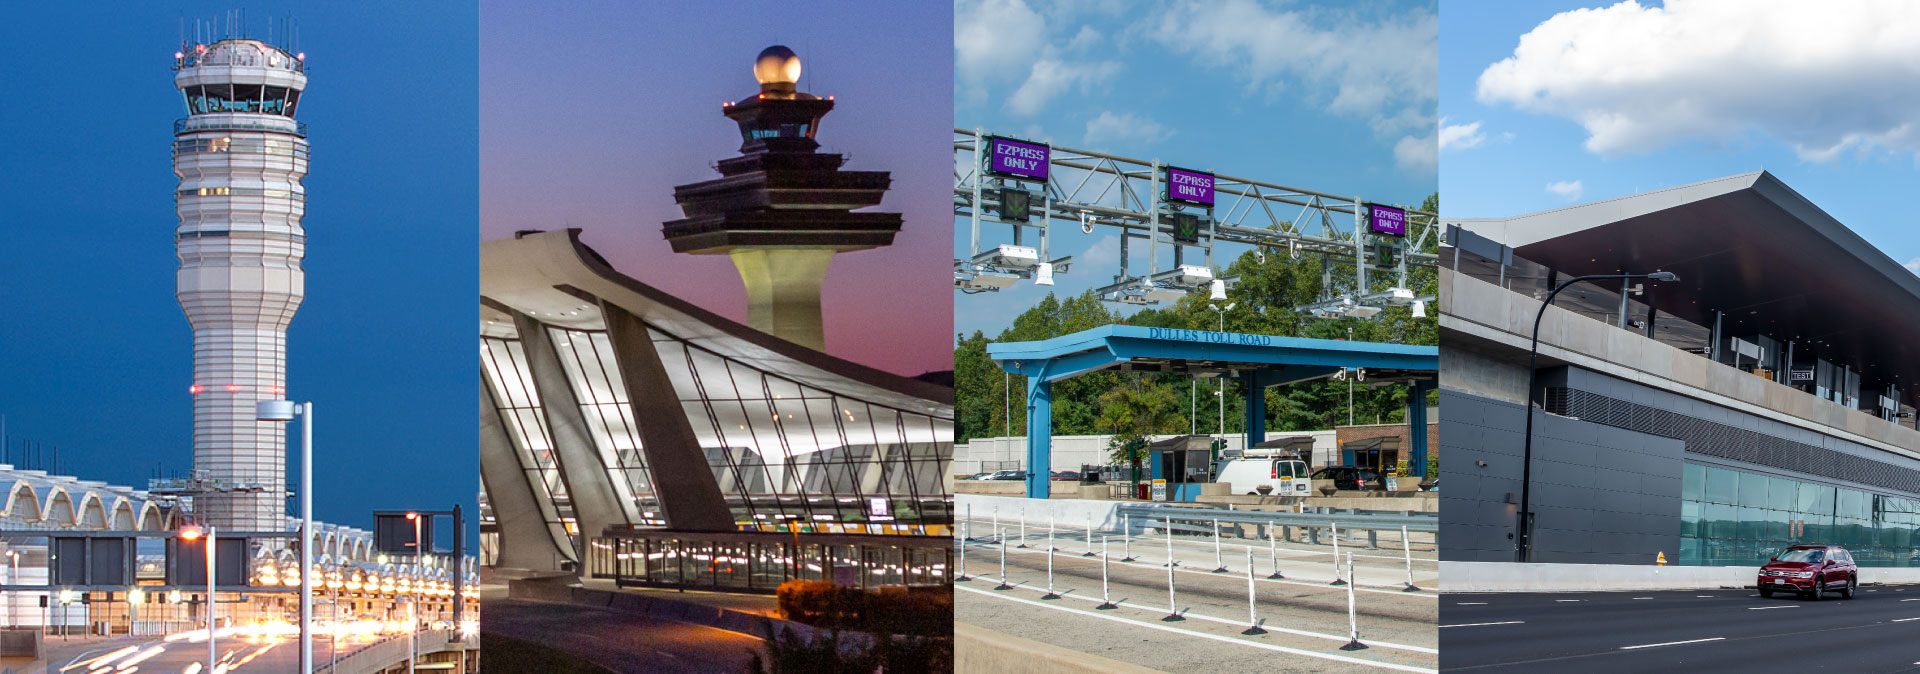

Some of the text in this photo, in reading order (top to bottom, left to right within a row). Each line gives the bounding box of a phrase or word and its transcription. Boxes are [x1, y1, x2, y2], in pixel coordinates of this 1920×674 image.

[997, 143, 1045, 160] EZPASS
[1004, 156, 1038, 171] ONLY
[1173, 173, 1211, 188] EZPASS
[1178, 184, 1206, 197] ONLY
[1374, 208, 1402, 221] EZPASS
[1379, 218, 1399, 229] ONLY
[1149, 327, 1271, 346] DULLES TOLL ROAD
